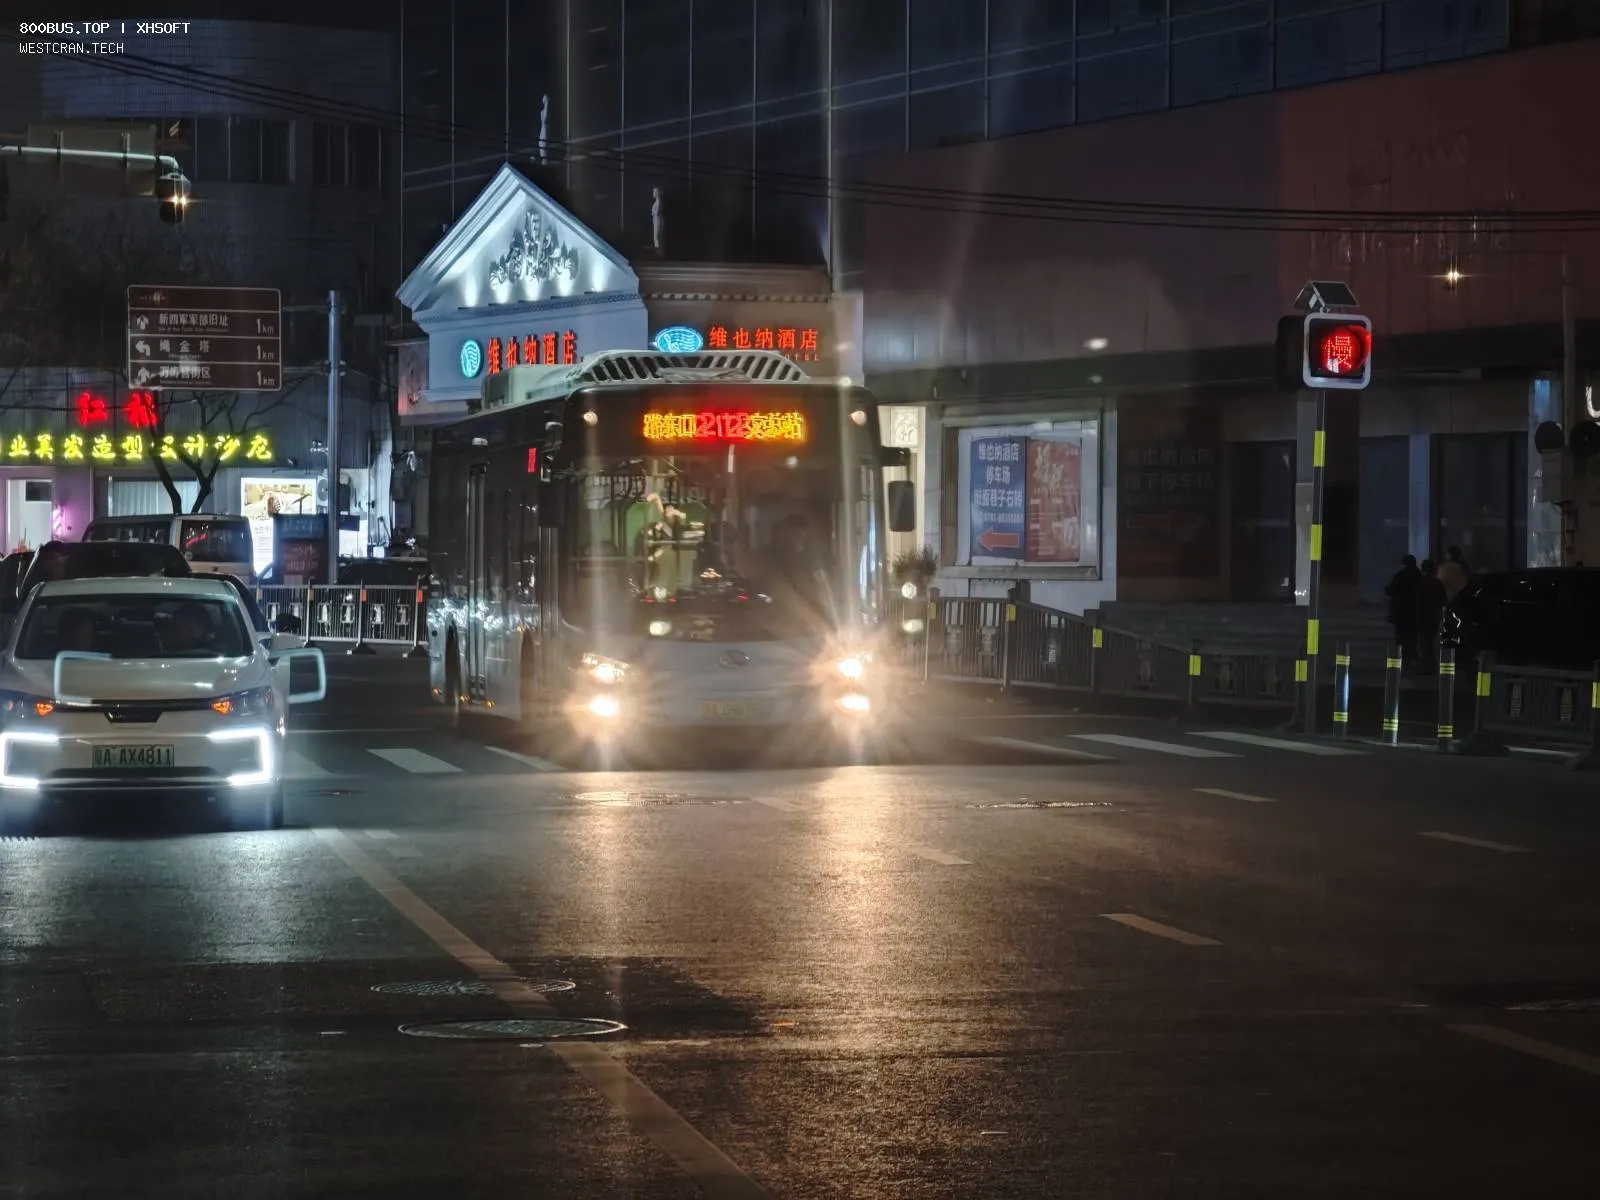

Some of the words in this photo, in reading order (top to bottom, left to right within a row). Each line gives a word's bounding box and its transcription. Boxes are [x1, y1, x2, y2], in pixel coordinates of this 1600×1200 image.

[709, 326, 819, 351] 维也纳酒店
[487, 329, 576, 376] 维也纳酒店
[0, 434, 272, 460] 业美发造型设计沙龙
[986, 464, 1011, 485] 停车场
[119, 747, 171, 766] AX4811
